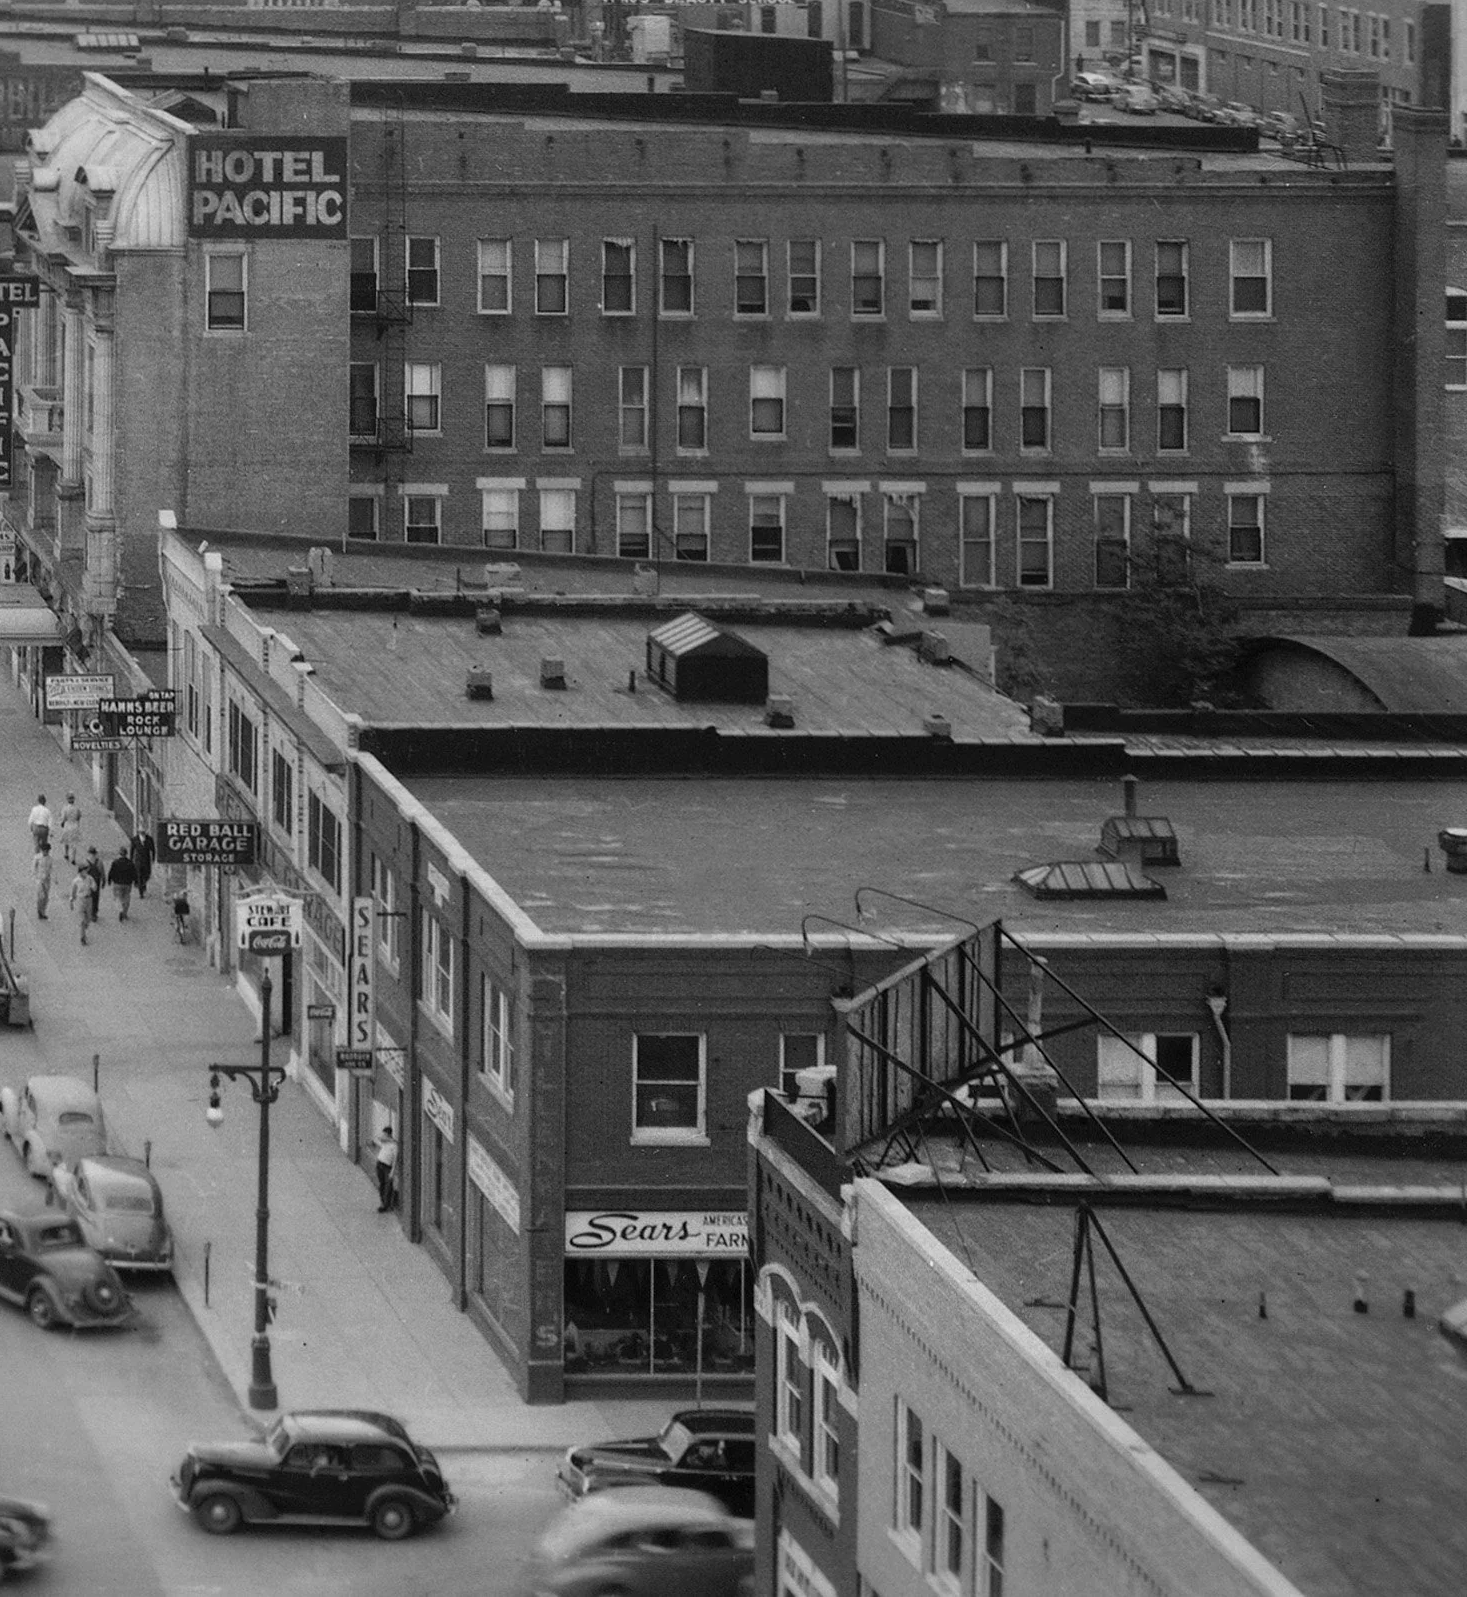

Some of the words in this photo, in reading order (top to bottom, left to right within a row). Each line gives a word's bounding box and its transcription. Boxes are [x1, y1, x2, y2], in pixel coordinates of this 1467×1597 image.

[195, 150, 340, 183] HOTEL
[193, 189, 344, 226] PACIFIC
[144, 701, 175, 713] BEER
[127, 715, 160, 725] ROCK
[119, 726, 168, 735] LOUNGE
[73, 741, 121, 750] NOVELTIES
[167, 824, 201, 837] RED
[209, 824, 251, 837] BALL
[169, 837, 248, 851] GARAGE
[183, 853, 235, 863] STORAGE
[247, 916, 291, 927] CAFE
[357, 906, 370, 1043] SEARS
[569, 1213, 701, 1249] Sears
